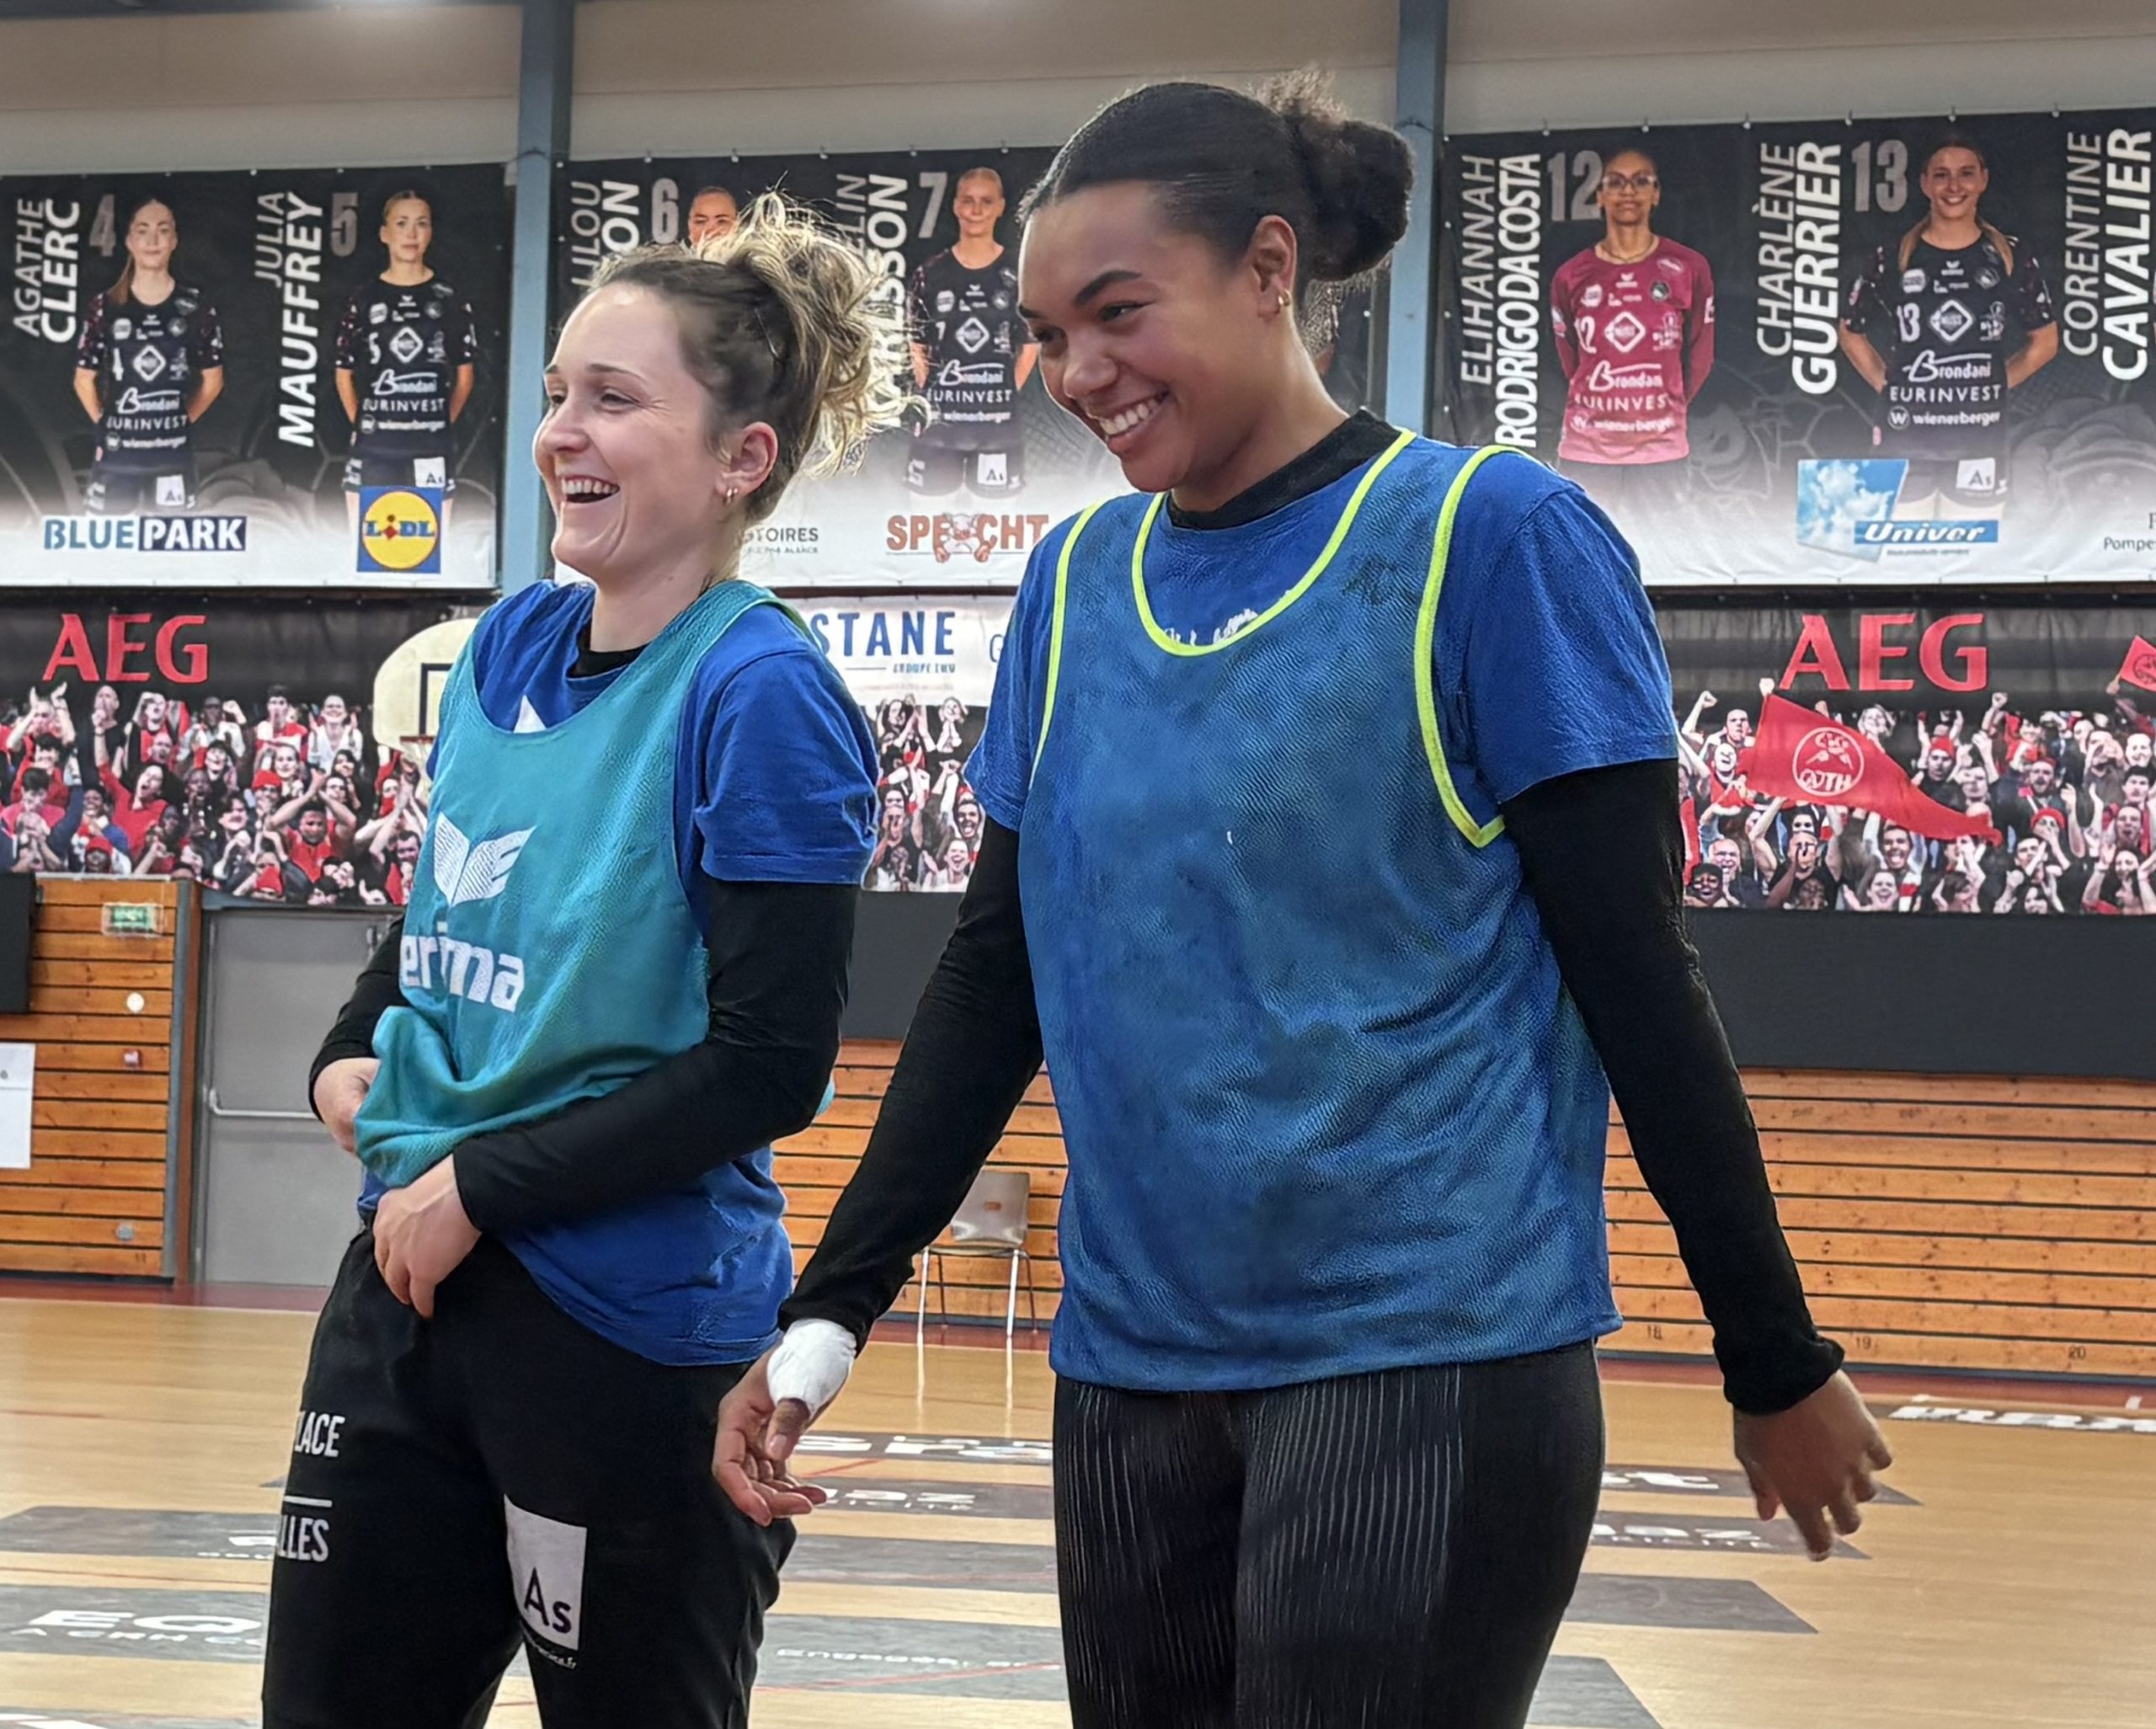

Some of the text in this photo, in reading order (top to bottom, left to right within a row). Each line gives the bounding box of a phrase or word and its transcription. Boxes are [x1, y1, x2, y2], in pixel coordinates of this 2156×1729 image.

[652, 178, 679, 244] 6
[919, 172, 947, 238] 7
[1546, 150, 1604, 222] 12
[1852, 139, 1908, 212] 13
[88, 194, 116, 256] 4
[254, 191, 286, 287] JULIA
[330, 192, 360, 257] 5
[1752, 142, 1796, 356] CHARLÈNE
[2063, 131, 2100, 355] CORENTINE
[2102, 128, 2151, 381] CAVALIER
[13, 197, 45, 337] AGATHE
[40, 199, 80, 343] CLERC
[1460, 155, 1496, 385] ELIHANNAH
[1791, 142, 1841, 394] GUERRIER
[278, 191, 323, 447] MAUFFREY
[1890, 384, 2001, 403] EURINVEST
[1902, 350, 1992, 382] Brondani
[1913, 411, 2001, 427] wienerberger
[1864, 521, 1987, 542] Univer
[2104, 536, 2156, 552] Pompe
[42, 613, 209, 684] AEG
[1779, 613, 1988, 691] AEG
[400, 921, 526, 1013] erima
[524, 1566, 572, 1635] As
